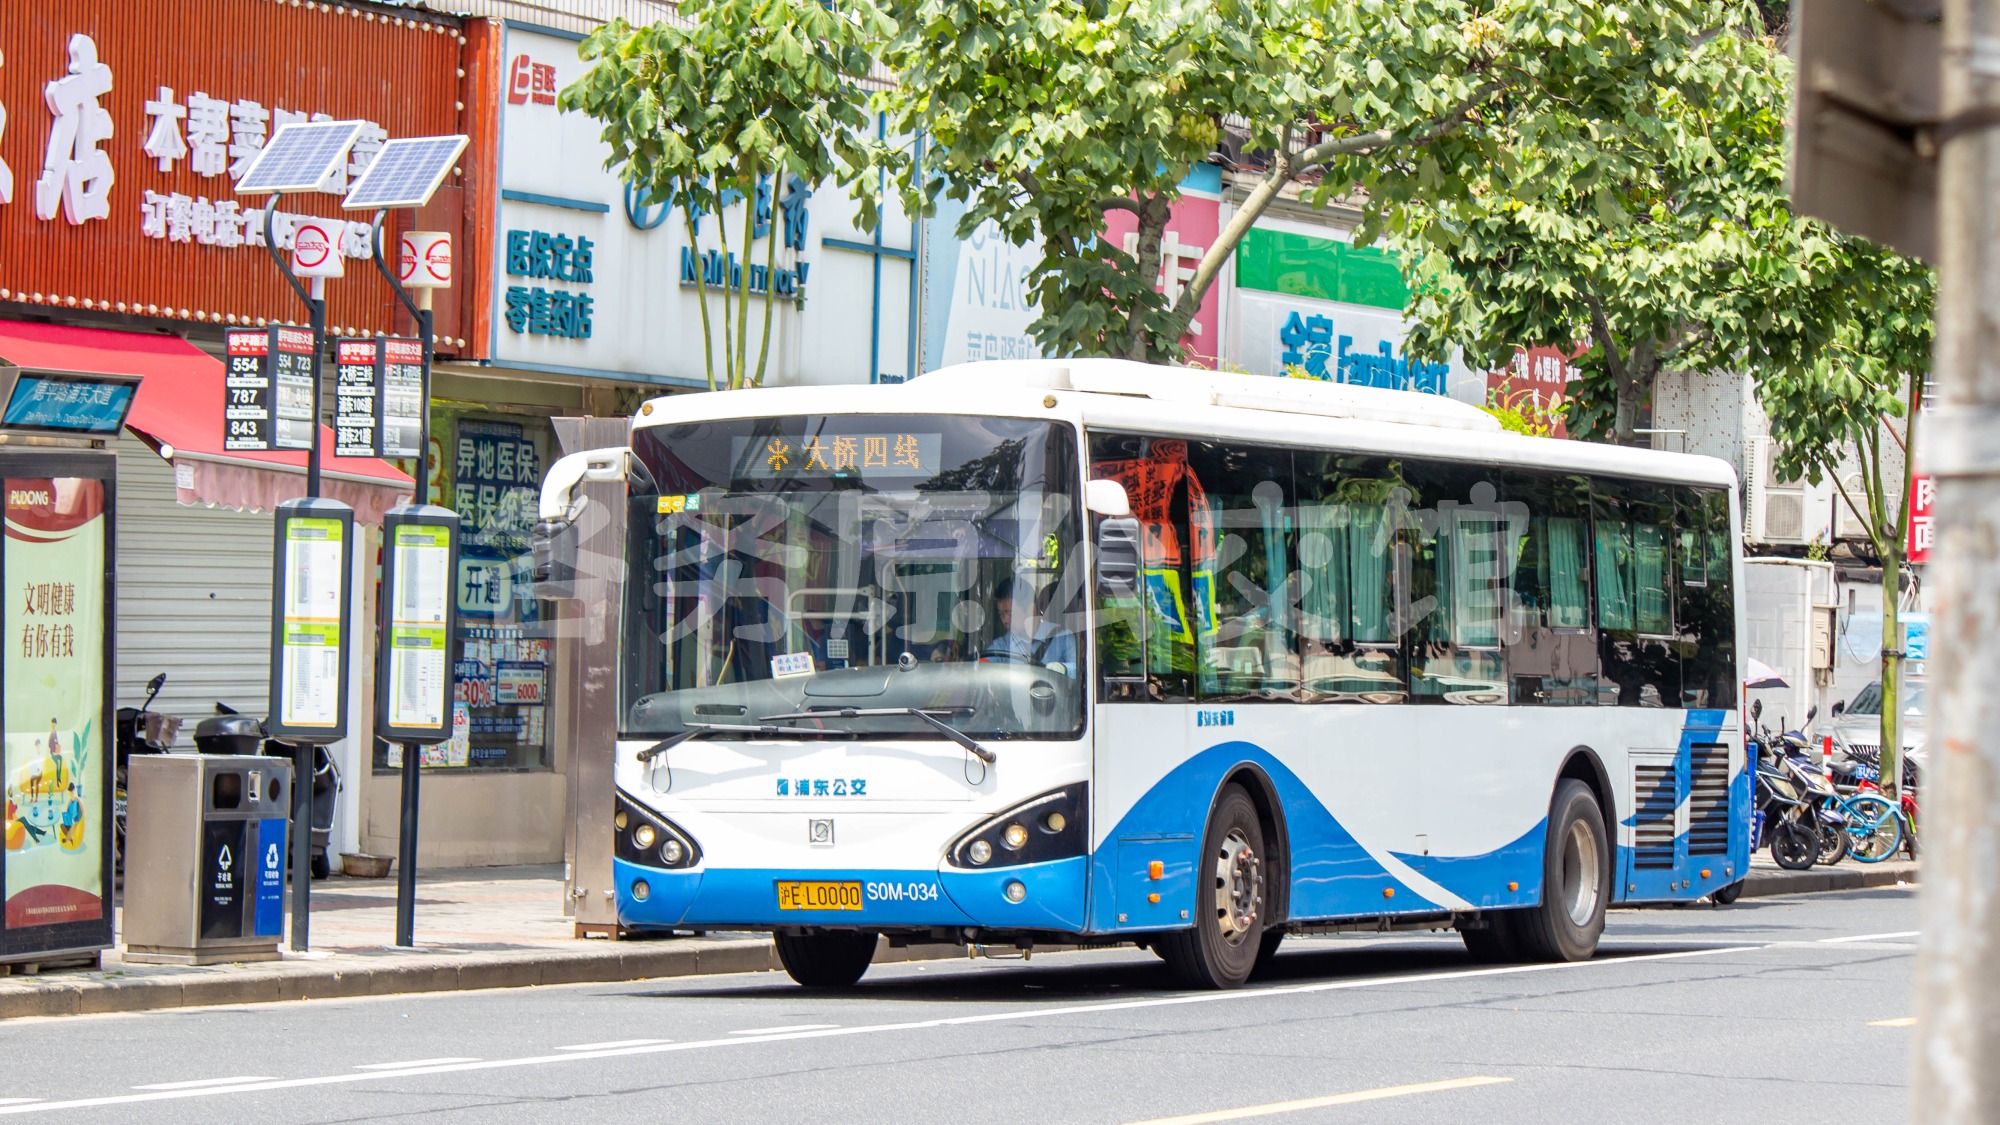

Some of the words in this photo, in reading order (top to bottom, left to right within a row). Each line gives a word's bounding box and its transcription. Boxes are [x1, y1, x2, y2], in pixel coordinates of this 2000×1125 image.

[0, 34, 115, 225] 店
[507, 230, 595, 284] 医保定点
[505, 286, 595, 339] 零售药店
[1280, 310, 1333, 381] 全家
[232, 357, 258, 372] 554
[278, 354, 292, 369] 554
[296, 356, 312, 371] 723
[339, 364, 373, 383] 大桥三线
[33, 382, 115, 406] 德平路浦东大道
[231, 390, 258, 404] 787
[231, 421, 257, 436] 843
[338, 427, 372, 444] 浦东21路
[457, 438, 534, 484] 异地医保
[804, 434, 920, 471] 大桥四线
[11, 490, 49, 505] PUDONG
[455, 483, 540, 533] 医保统筹
[22, 582, 75, 617] 文明健康
[465, 565, 501, 605] 开通
[22, 623, 74, 658] 有你有我
[462, 678, 491, 708] 30%
[517, 683, 538, 700] 6000
[795, 779, 867, 796] 浦东公交
